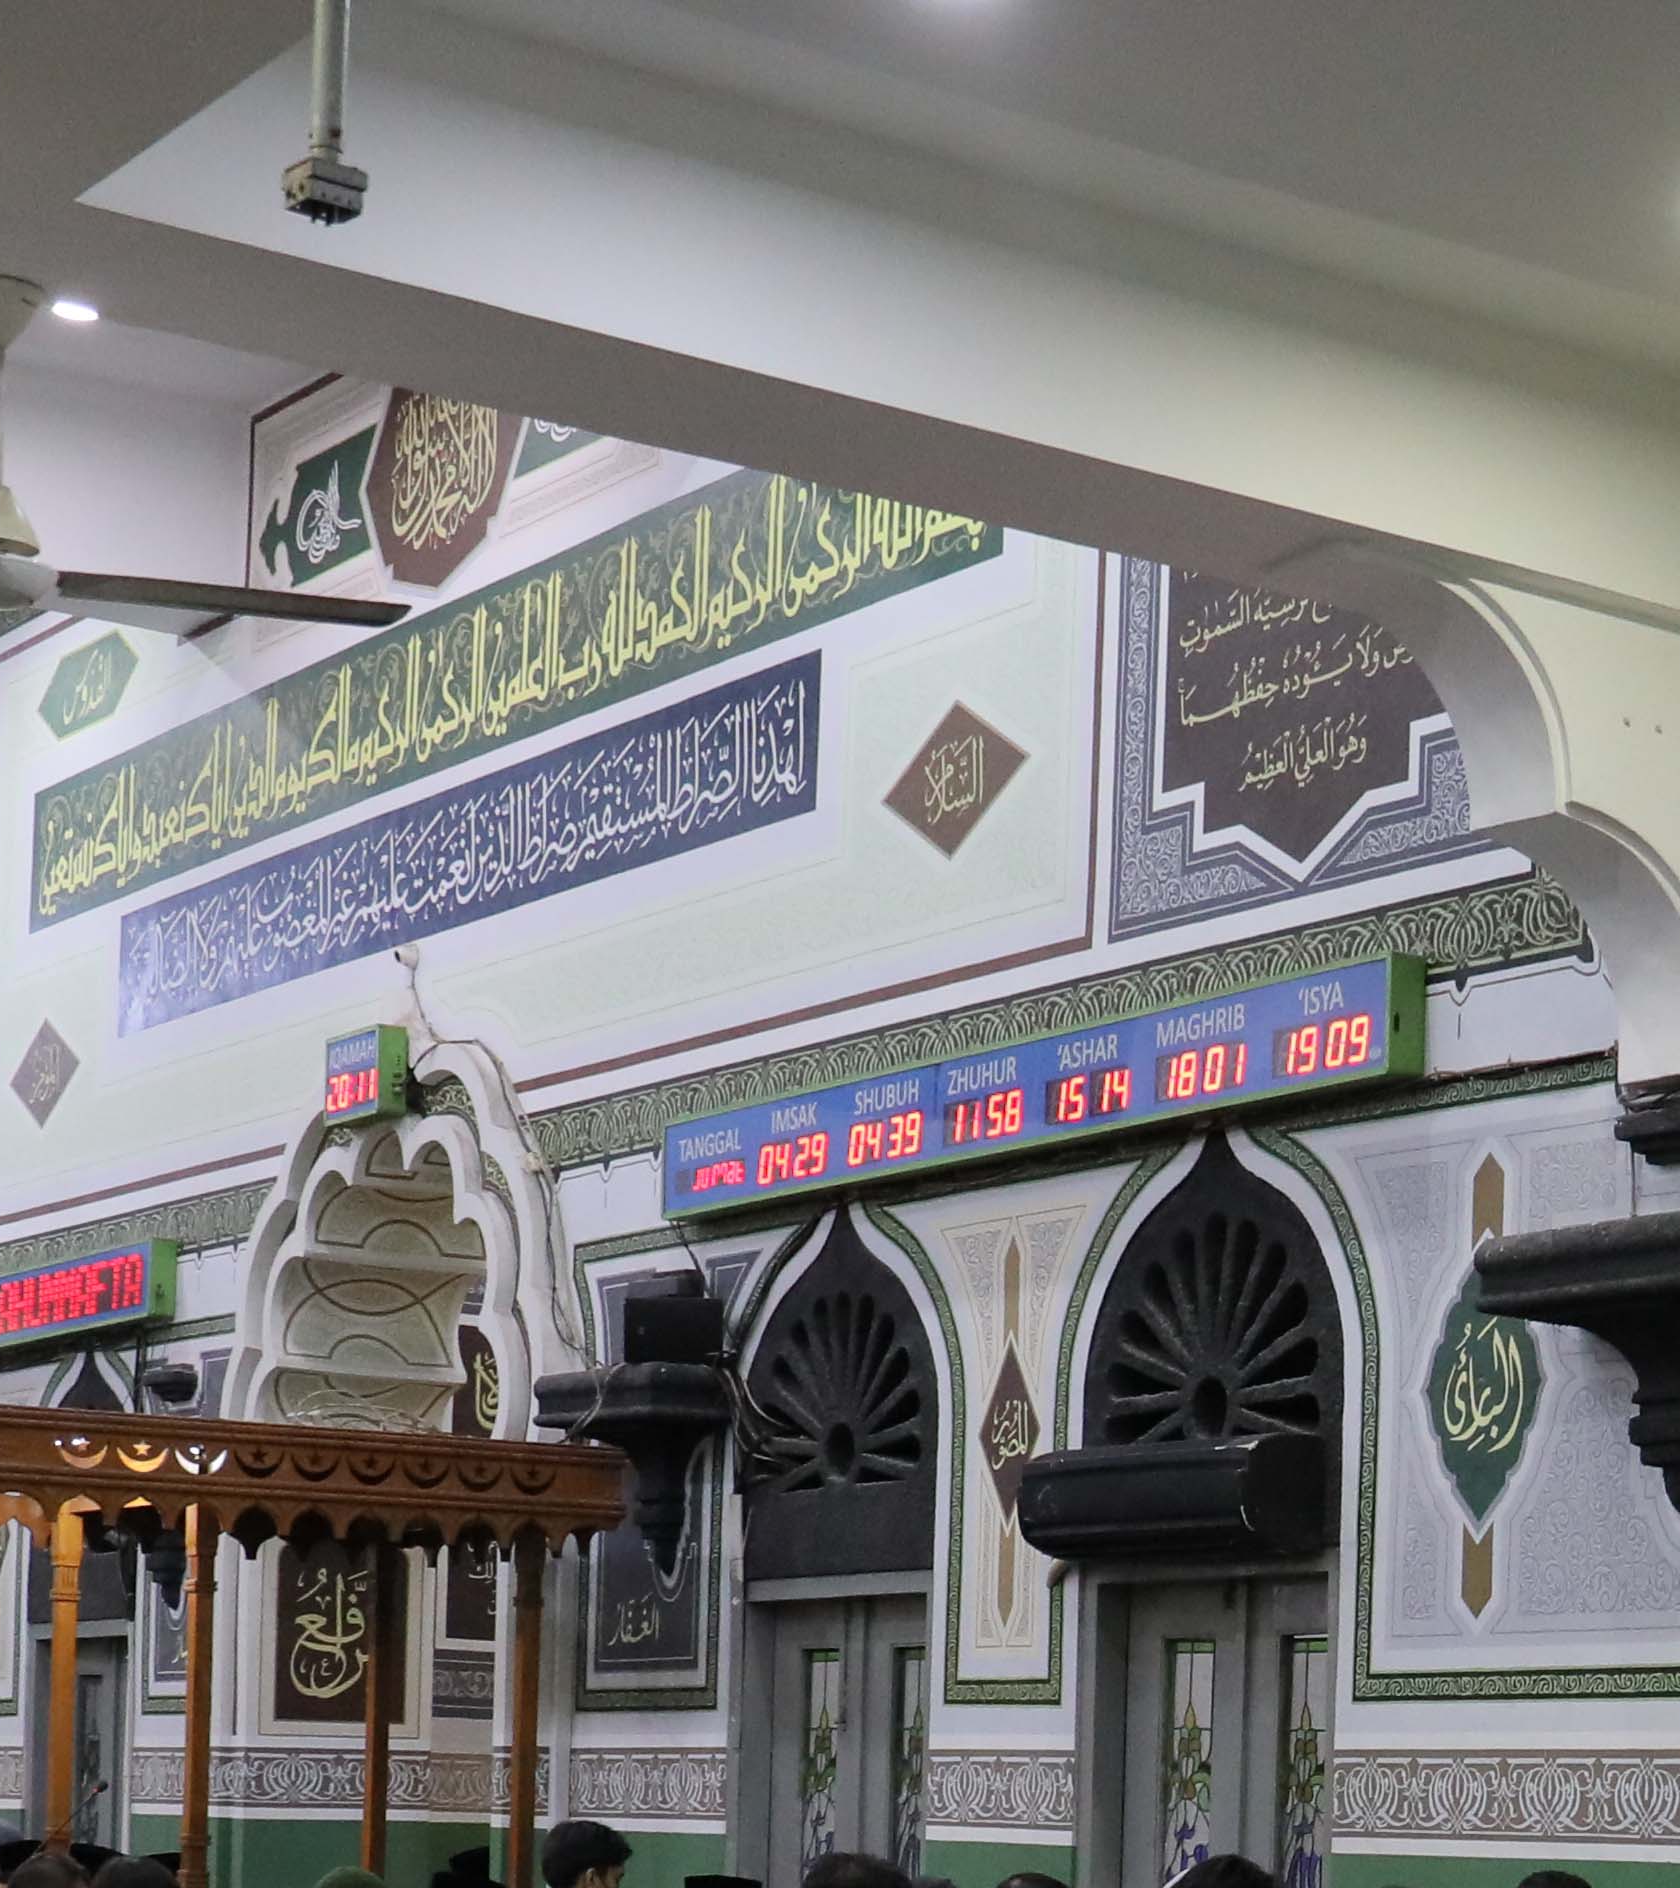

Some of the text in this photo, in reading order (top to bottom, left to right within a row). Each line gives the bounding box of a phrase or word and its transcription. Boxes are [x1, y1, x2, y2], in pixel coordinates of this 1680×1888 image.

[1156, 1003, 1246, 1048] MAGHRIB
[947, 1056, 1017, 1096] ZHUHUR
[854, 1079, 920, 1116] SHUBUH
[770, 1102, 817, 1135] IMSAK
[678, 1128, 742, 1162] TANGGAL
